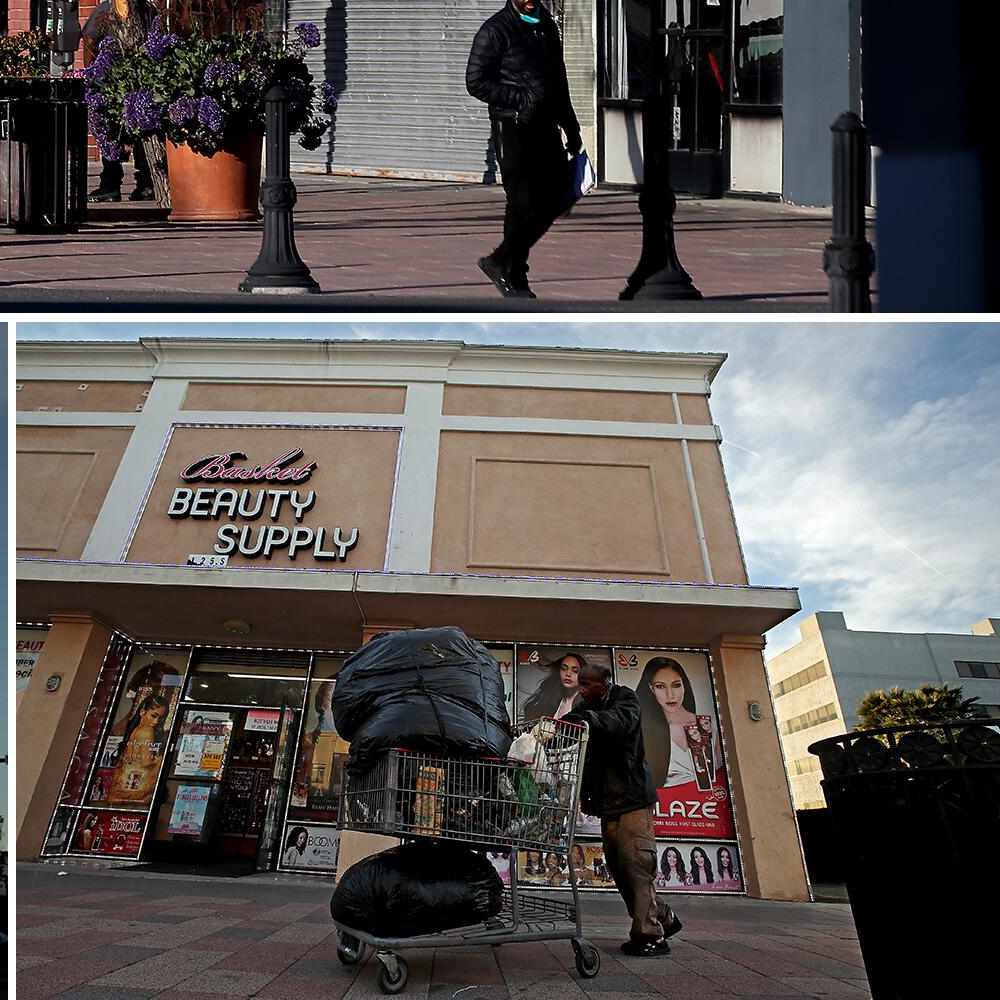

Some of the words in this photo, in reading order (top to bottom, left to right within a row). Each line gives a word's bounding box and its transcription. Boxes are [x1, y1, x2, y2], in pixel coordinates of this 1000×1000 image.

[180, 448, 318, 483] Basket
[167, 487, 316, 522] BEAUTY
[214, 523, 359, 562] SUPPLY
[16, 640, 45, 650] EAUT
[652, 799, 720, 820] LAZE
